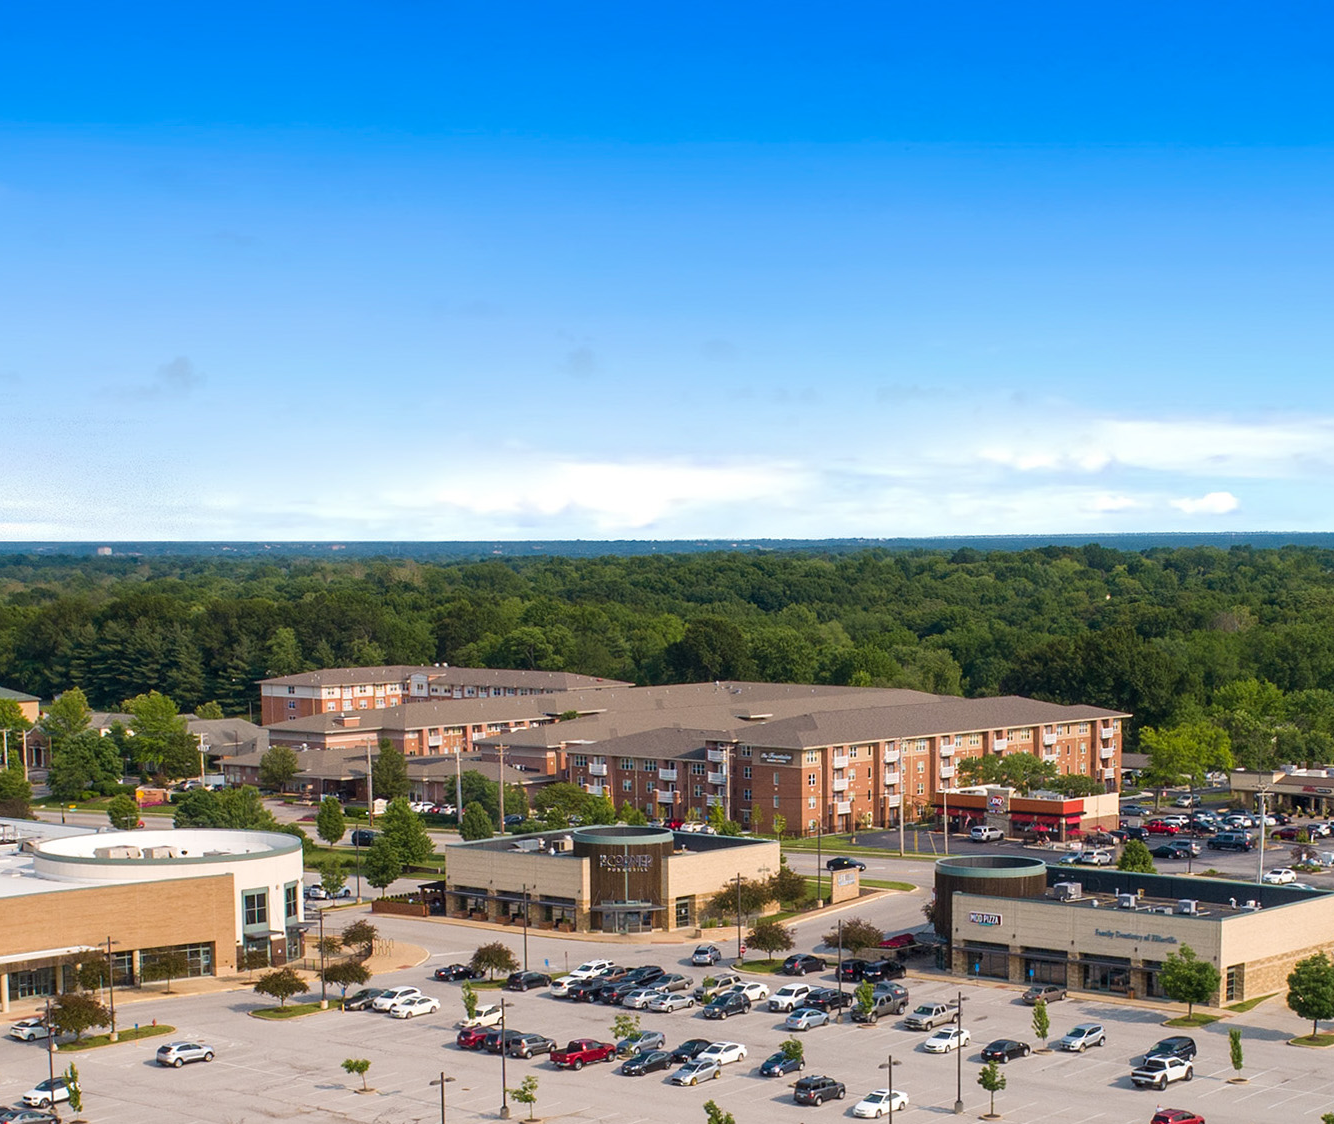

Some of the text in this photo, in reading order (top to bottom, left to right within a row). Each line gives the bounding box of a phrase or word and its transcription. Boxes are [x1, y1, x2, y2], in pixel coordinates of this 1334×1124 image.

[607, 854, 654, 868] CORNER
[970, 913, 983, 923] MOD
[983, 914, 999, 925] PIZZA
